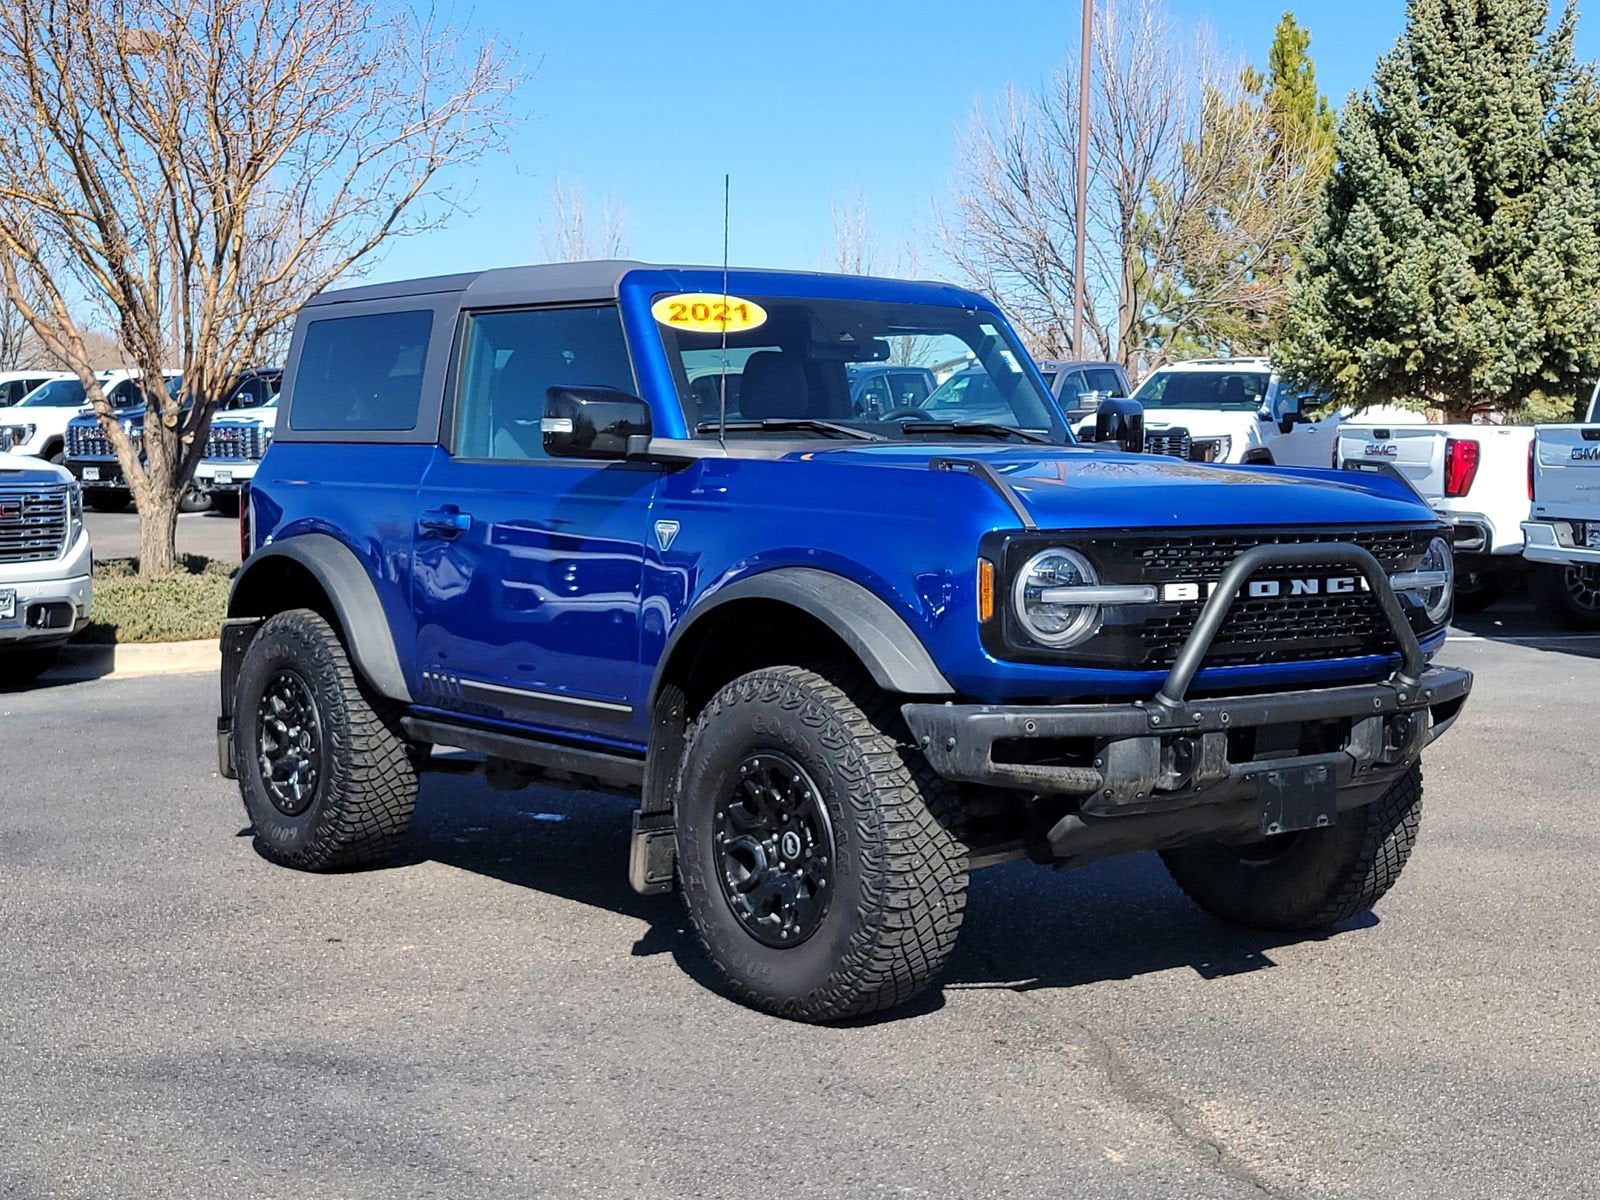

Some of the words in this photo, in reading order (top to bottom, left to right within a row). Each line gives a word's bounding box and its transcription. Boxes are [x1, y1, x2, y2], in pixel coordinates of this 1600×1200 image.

[669, 303, 750, 321] 2021
[1365, 443, 1398, 457] GMC
[1571, 447, 1600, 461] GM
